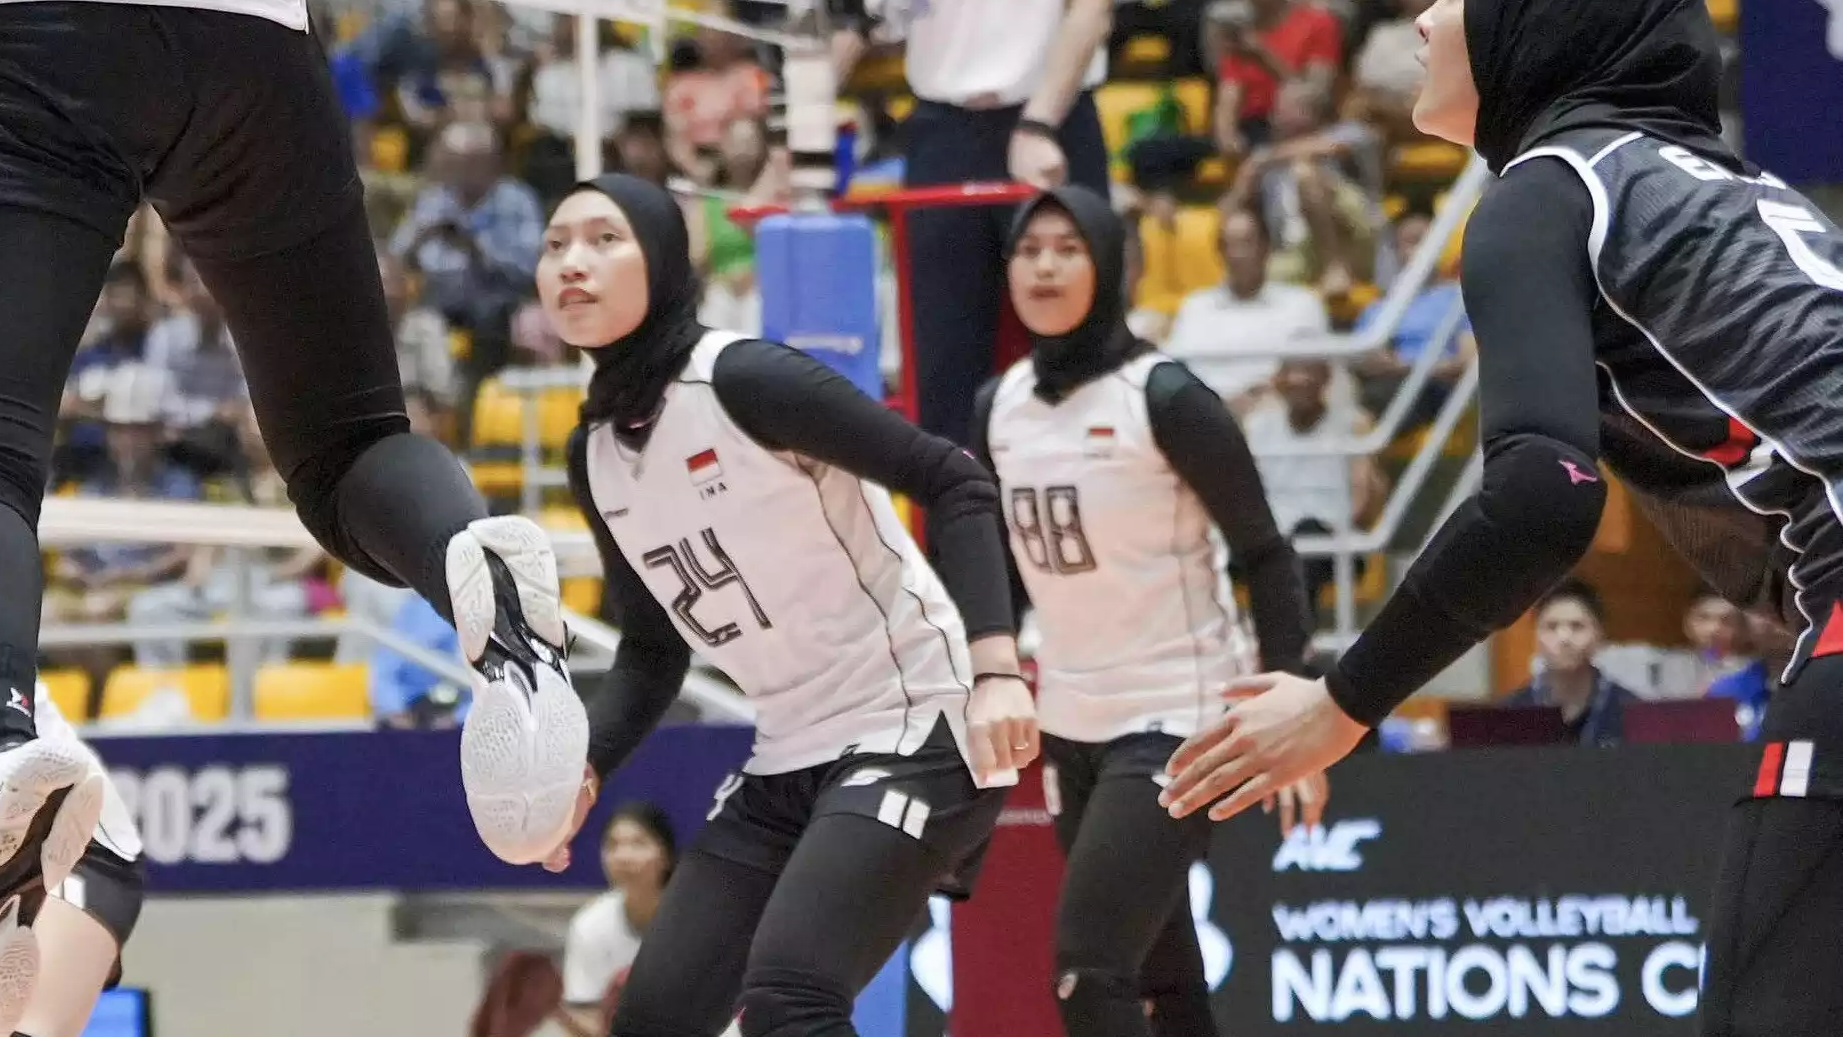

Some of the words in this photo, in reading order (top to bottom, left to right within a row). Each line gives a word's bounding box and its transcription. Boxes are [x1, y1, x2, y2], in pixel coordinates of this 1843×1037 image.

[1010, 485, 1097, 576] 88
[642, 526, 775, 649] 24
[1271, 896, 1458, 942] WOMEN'S
[1463, 893, 1700, 937] VOLLEYBALL
[1271, 942, 1621, 1022] NATIONS
[1641, 939, 1708, 1018] C
